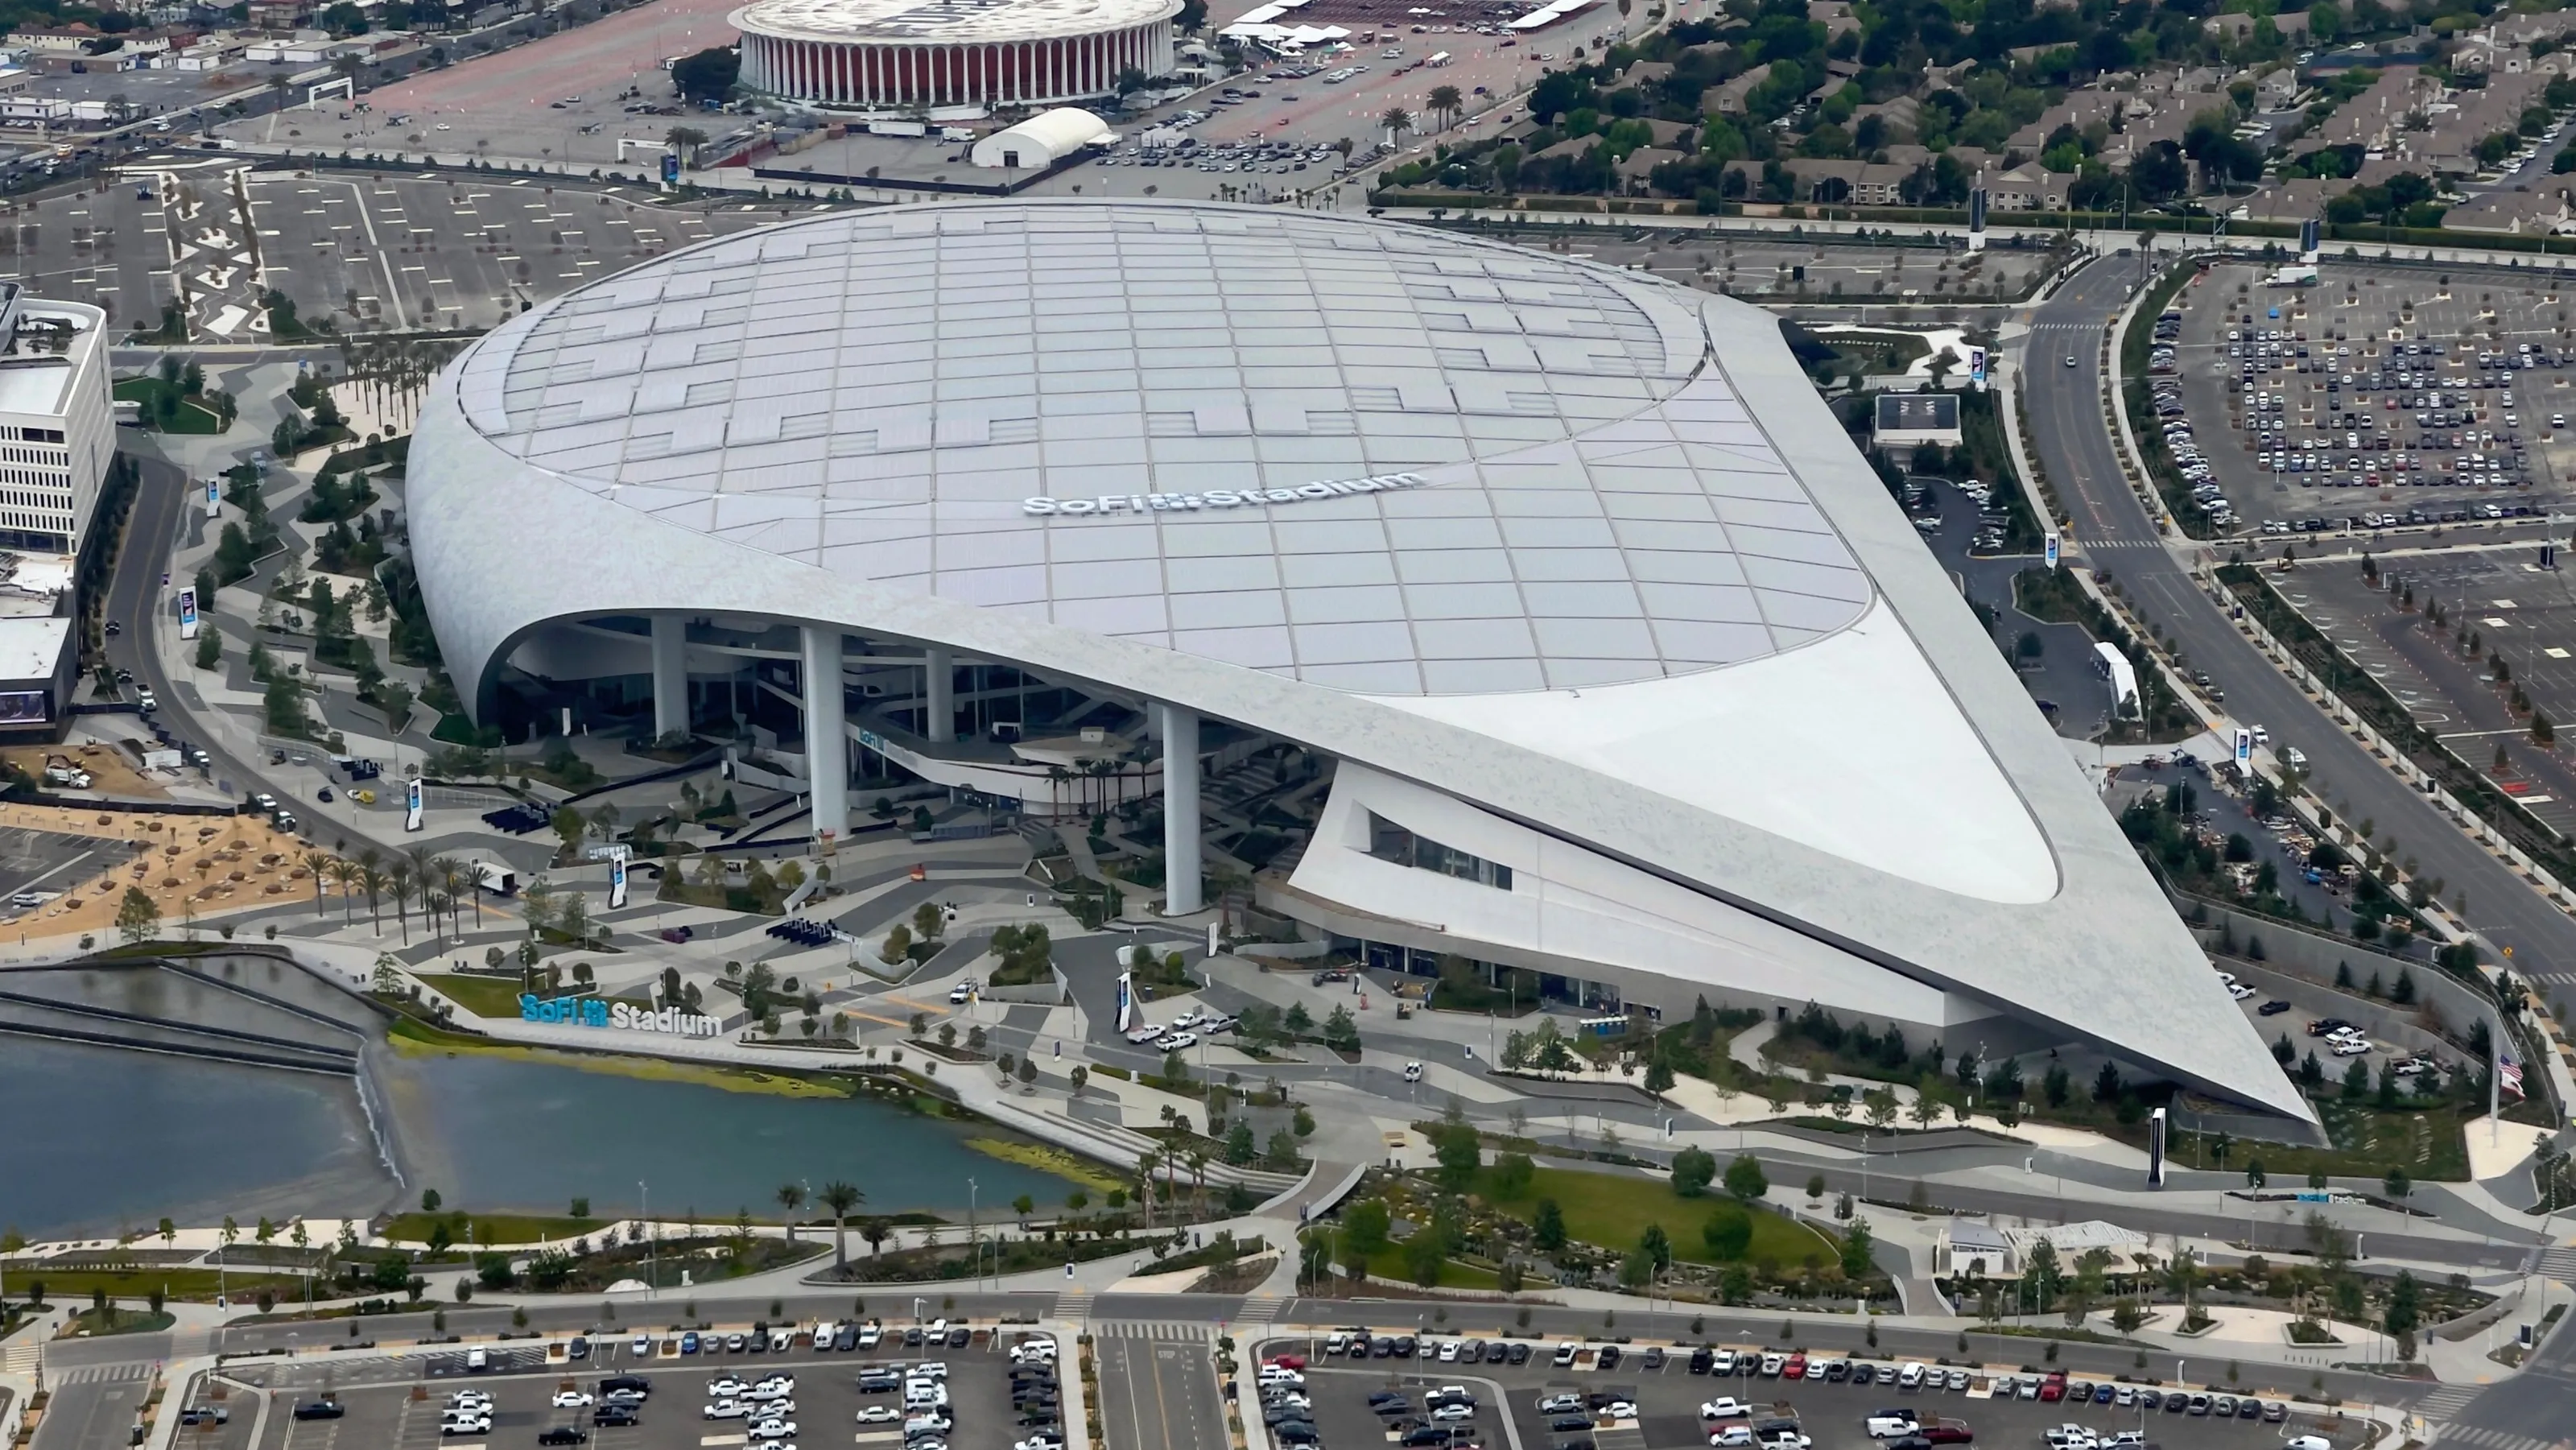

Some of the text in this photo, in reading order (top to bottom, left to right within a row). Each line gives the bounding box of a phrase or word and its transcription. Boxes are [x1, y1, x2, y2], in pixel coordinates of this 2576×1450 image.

[1023, 469, 1429, 515] SoFi Stadium
[522, 994, 723, 1037] SoFi Stadium
